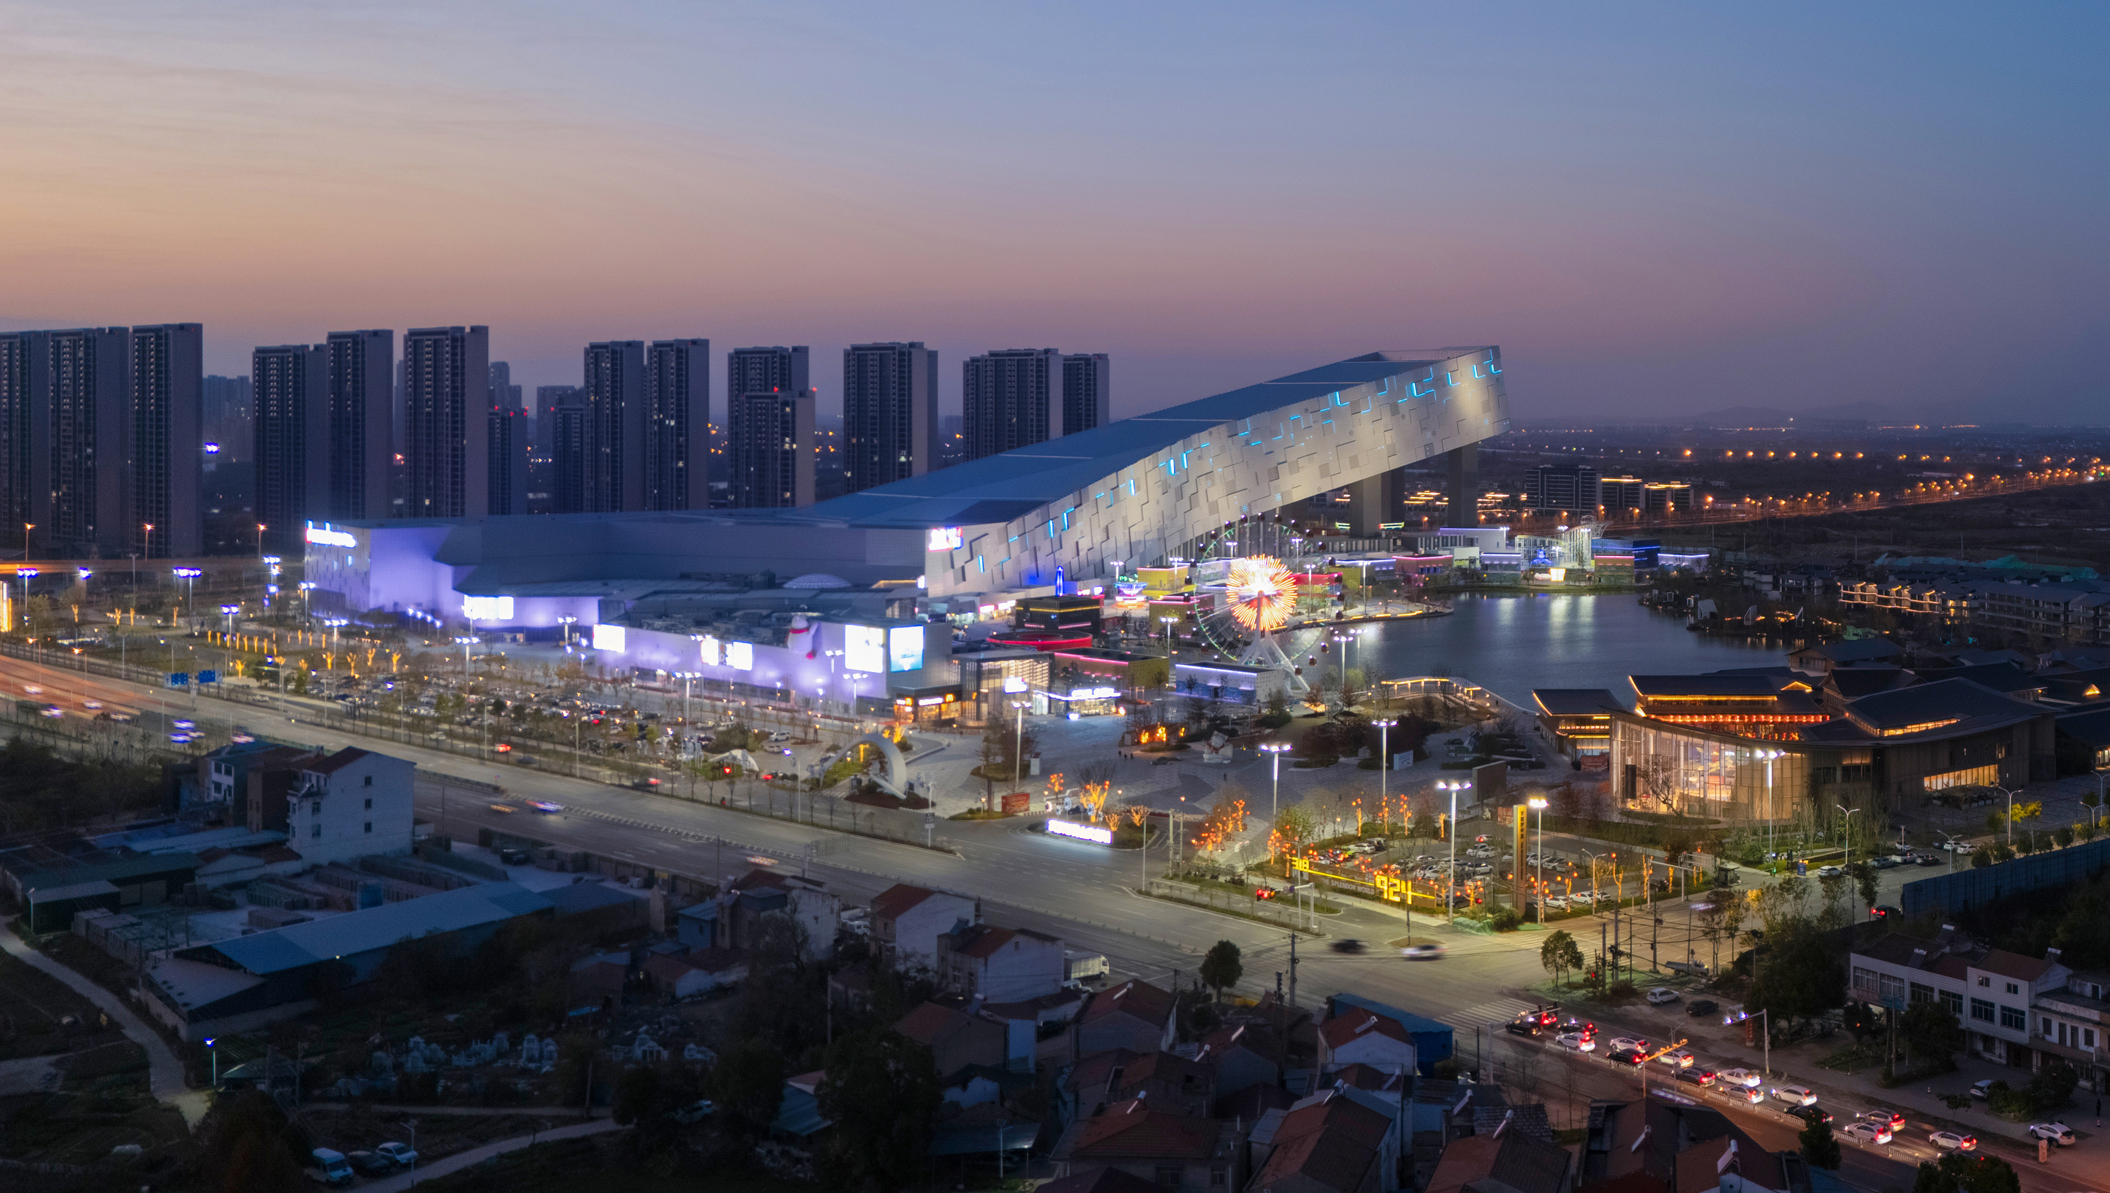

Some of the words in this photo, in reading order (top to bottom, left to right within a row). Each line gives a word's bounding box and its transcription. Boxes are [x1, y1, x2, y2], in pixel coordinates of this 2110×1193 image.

[1291, 856, 1310, 872] 318
[1330, 880, 1357, 890] SPLENDOR
[1356, 885, 1375, 895] WORLD
[1375, 874, 1413, 905] 924
